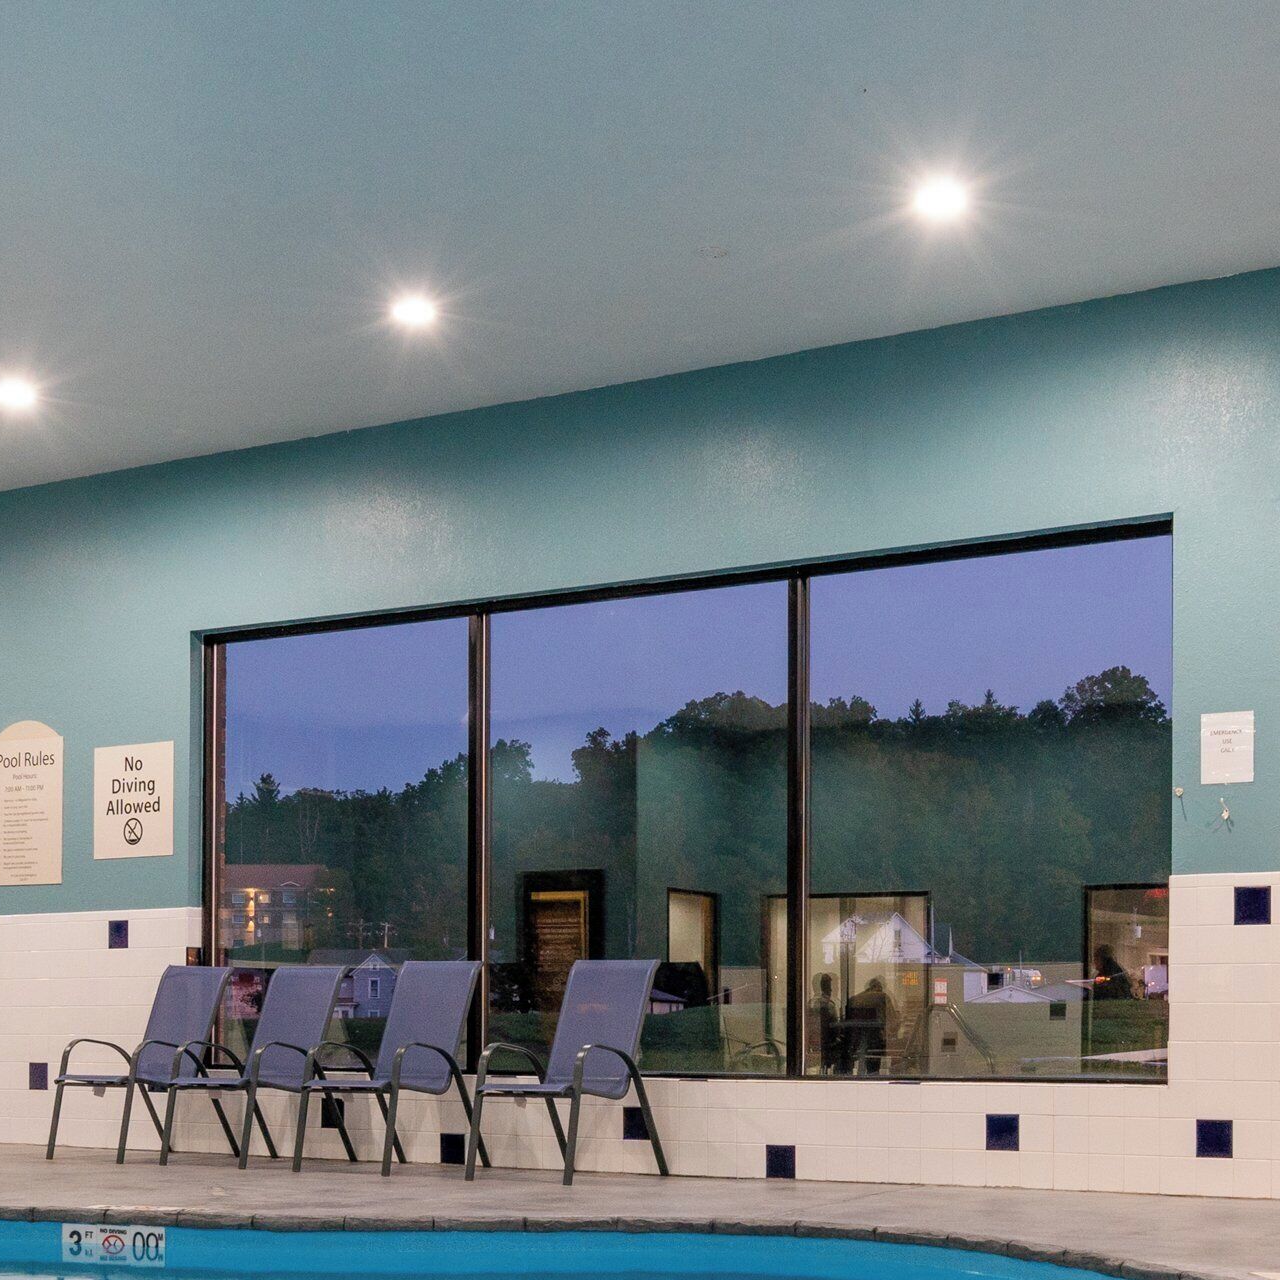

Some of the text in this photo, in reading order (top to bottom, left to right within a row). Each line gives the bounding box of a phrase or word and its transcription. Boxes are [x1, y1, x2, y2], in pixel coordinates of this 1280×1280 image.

[24, 750, 55, 767] Rules
[124, 756, 143, 772] No
[111, 777, 155, 796] Diving
[106, 796, 160, 816] Allowed
[84, 1231, 94, 1239] FT
